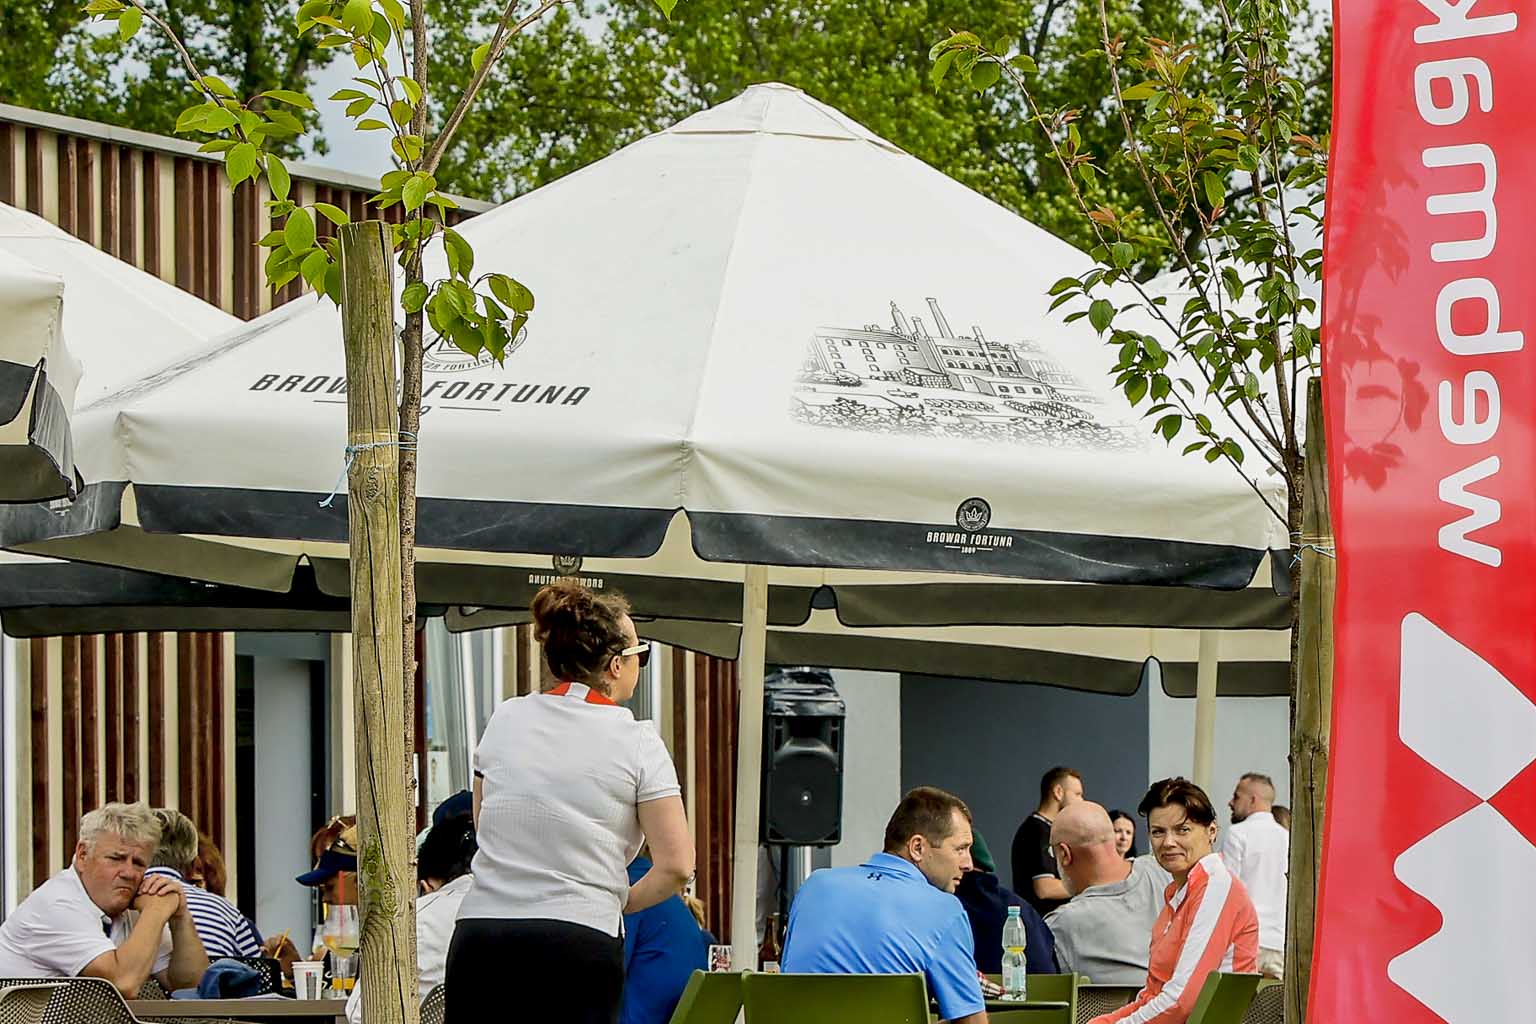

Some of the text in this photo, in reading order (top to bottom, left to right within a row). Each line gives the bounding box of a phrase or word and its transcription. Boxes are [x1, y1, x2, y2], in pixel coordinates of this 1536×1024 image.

[421, 379, 592, 407] FORTUNA
[926, 531, 1013, 548] BROWAR FORTUNA
